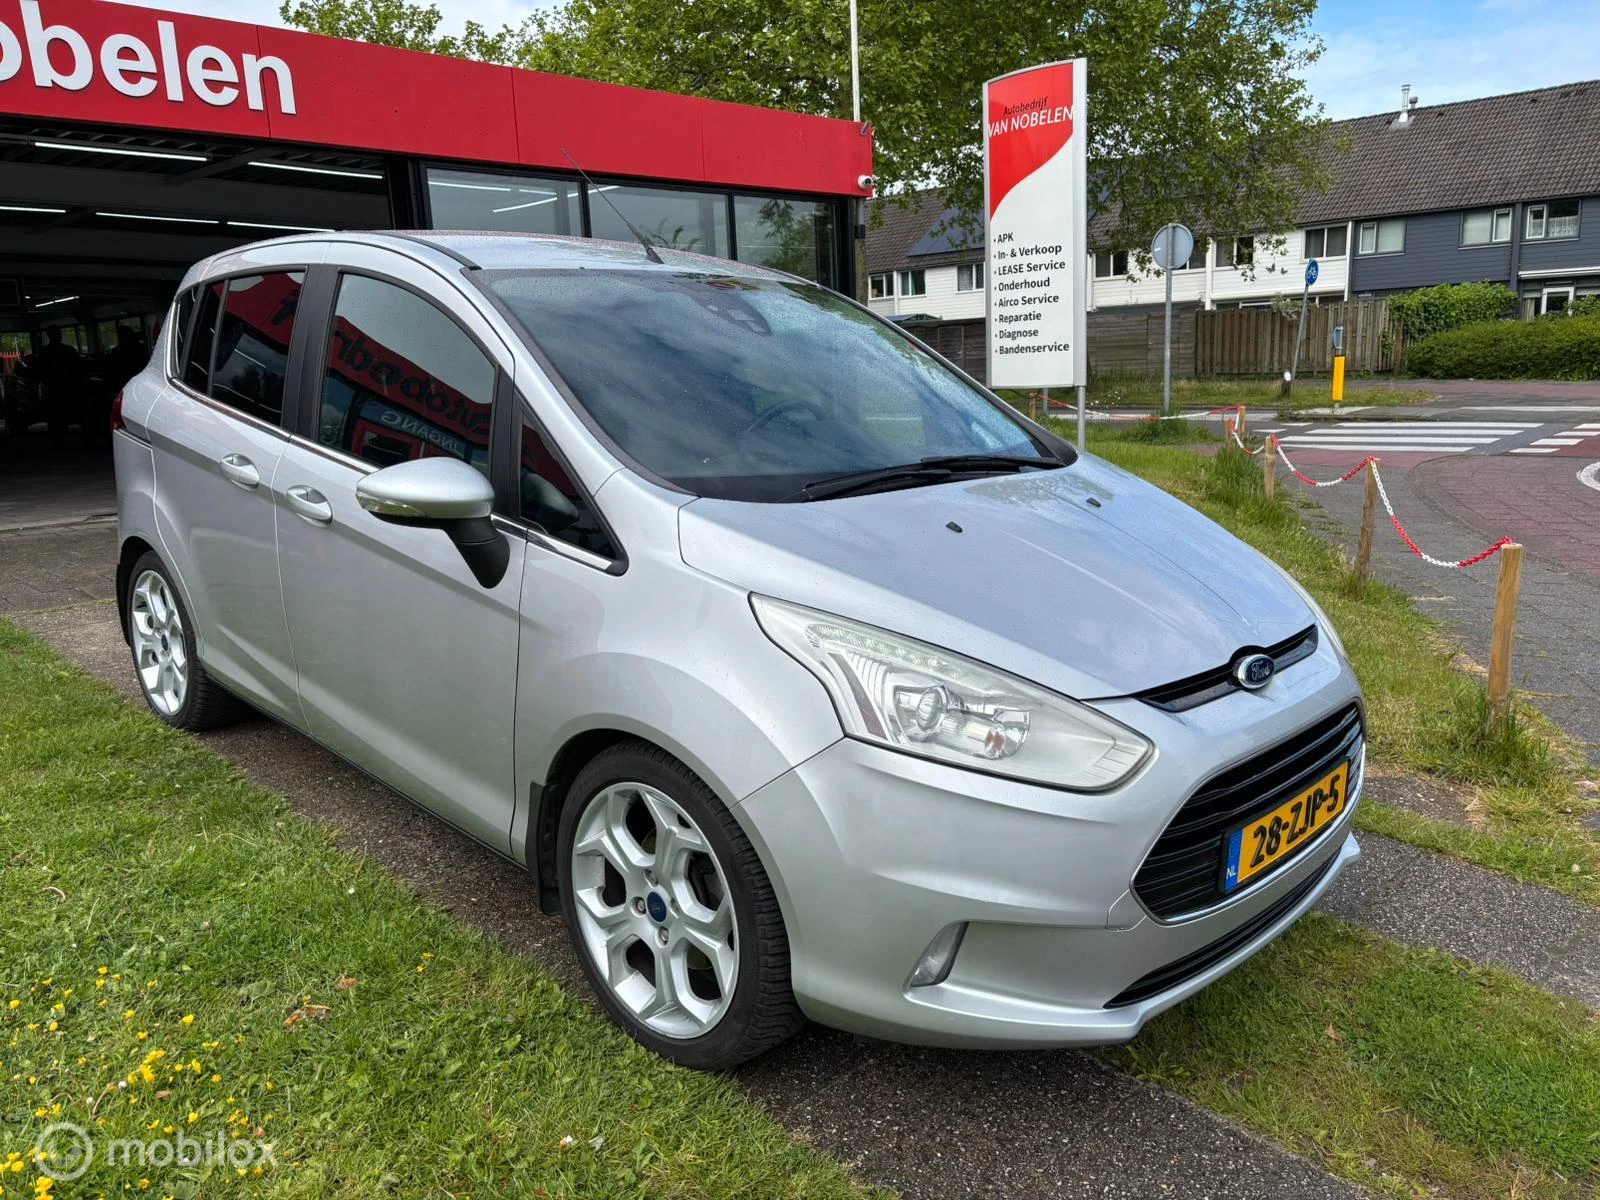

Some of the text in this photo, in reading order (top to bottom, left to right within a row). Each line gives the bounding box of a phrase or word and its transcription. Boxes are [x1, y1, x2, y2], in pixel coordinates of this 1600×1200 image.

[1003, 97, 1048, 117] Autobedrijf
[988, 105, 1074, 137] VAN NOBELEN
[997, 232, 1014, 244] APK
[998, 244, 1062, 260] In- & Verkoop
[998, 259, 1066, 276] LEASE Service
[998, 277, 1051, 291] Onderhoud
[998, 293, 1060, 307] Airco Service
[998, 310, 1042, 324] Reparatie
[999, 329, 1039, 340] Diagnose
[999, 341, 1070, 355] Bandenservice
[1250, 660, 1270, 681] Ford
[1250, 774, 1341, 868] 28-ZJP-5
[1225, 864, 1237, 880] NL
